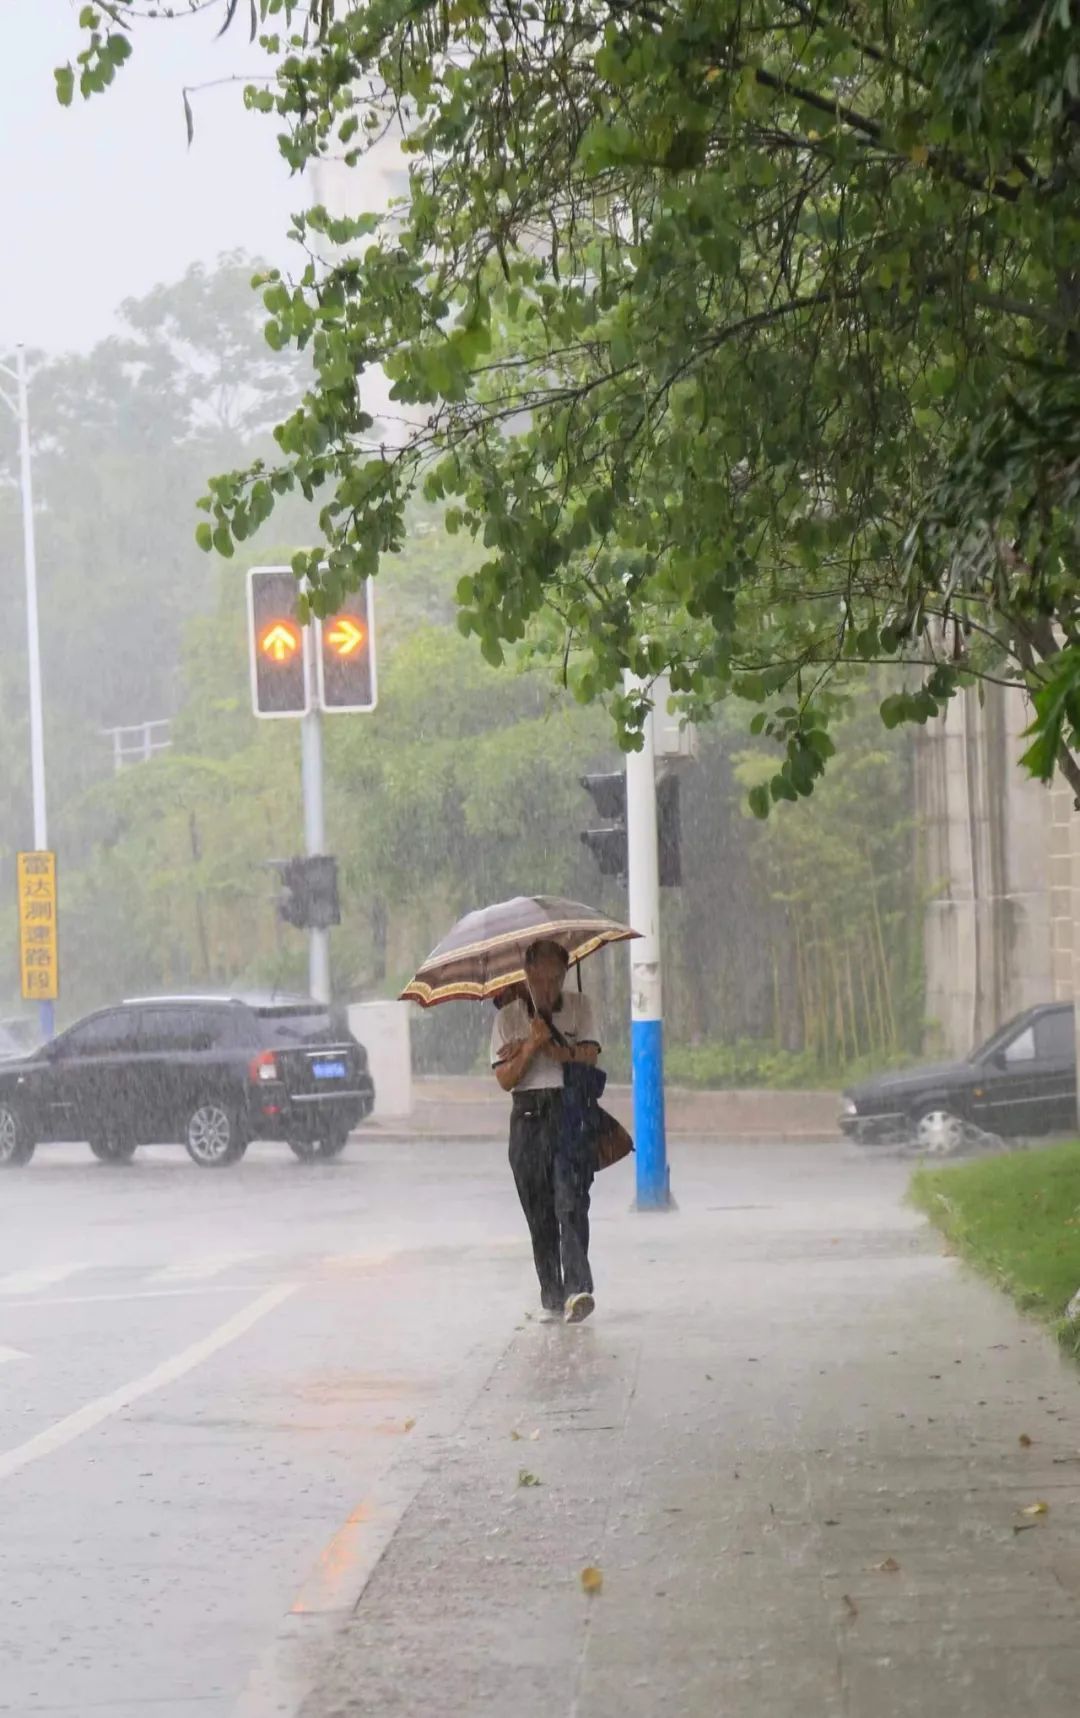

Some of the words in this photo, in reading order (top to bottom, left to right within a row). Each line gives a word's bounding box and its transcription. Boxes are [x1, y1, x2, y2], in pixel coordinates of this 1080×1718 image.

[23, 855, 52, 990] 雷达测速路段
